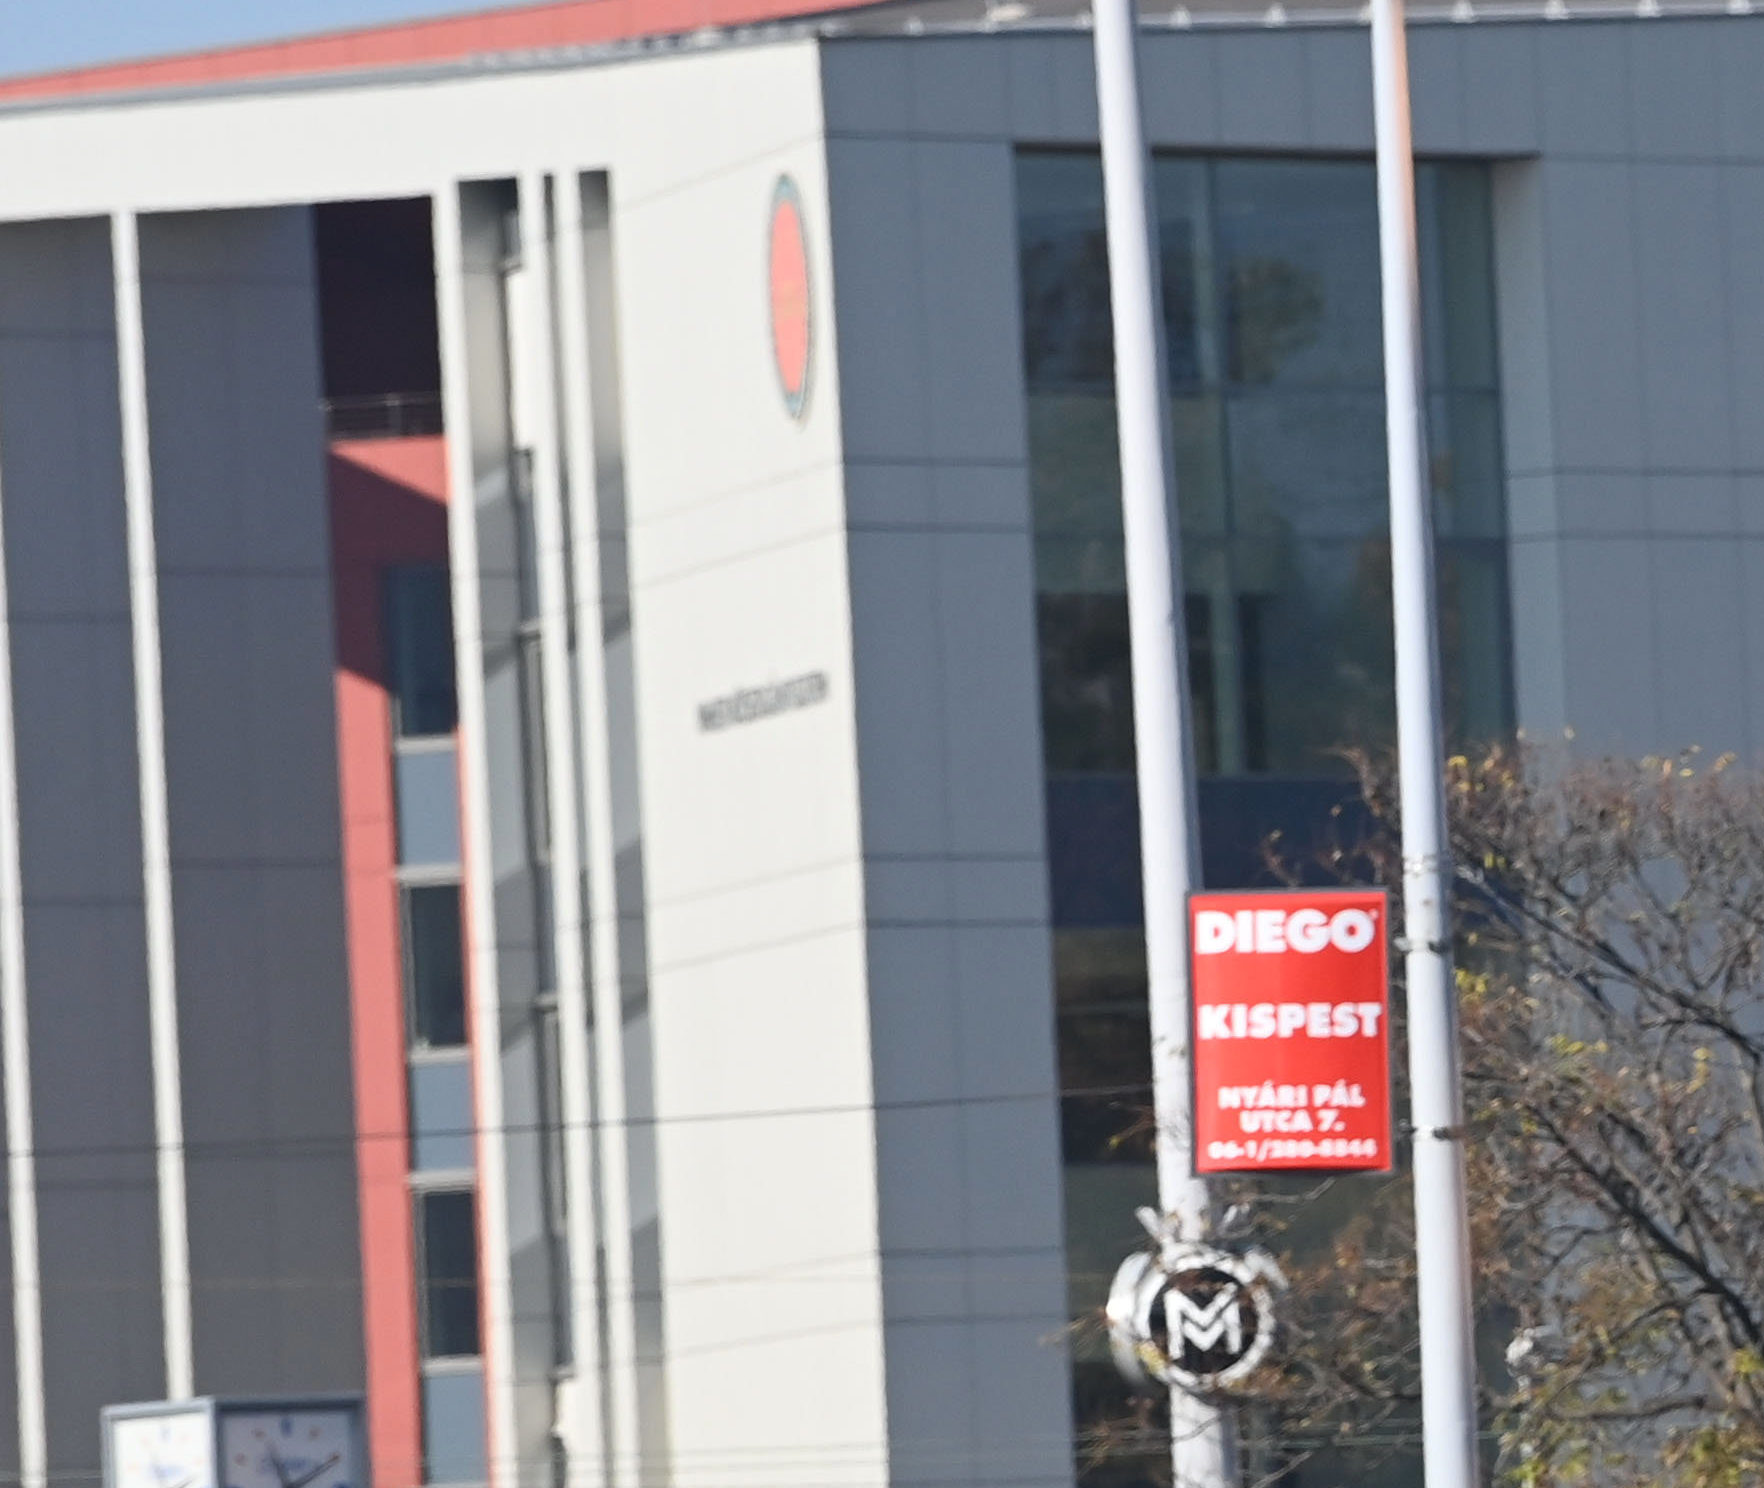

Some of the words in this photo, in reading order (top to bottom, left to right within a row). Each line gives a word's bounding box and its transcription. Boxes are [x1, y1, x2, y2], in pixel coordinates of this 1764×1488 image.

[1195, 908, 1375, 955] DIEGO
[1198, 1002, 1382, 1039] KISPEST
[1217, 1080, 1308, 1109] NYÁRI
[1312, 1079, 1366, 1107] PÁL
[1239, 1109, 1313, 1133] UTCA
[1317, 1109, 1346, 1132] 7.
